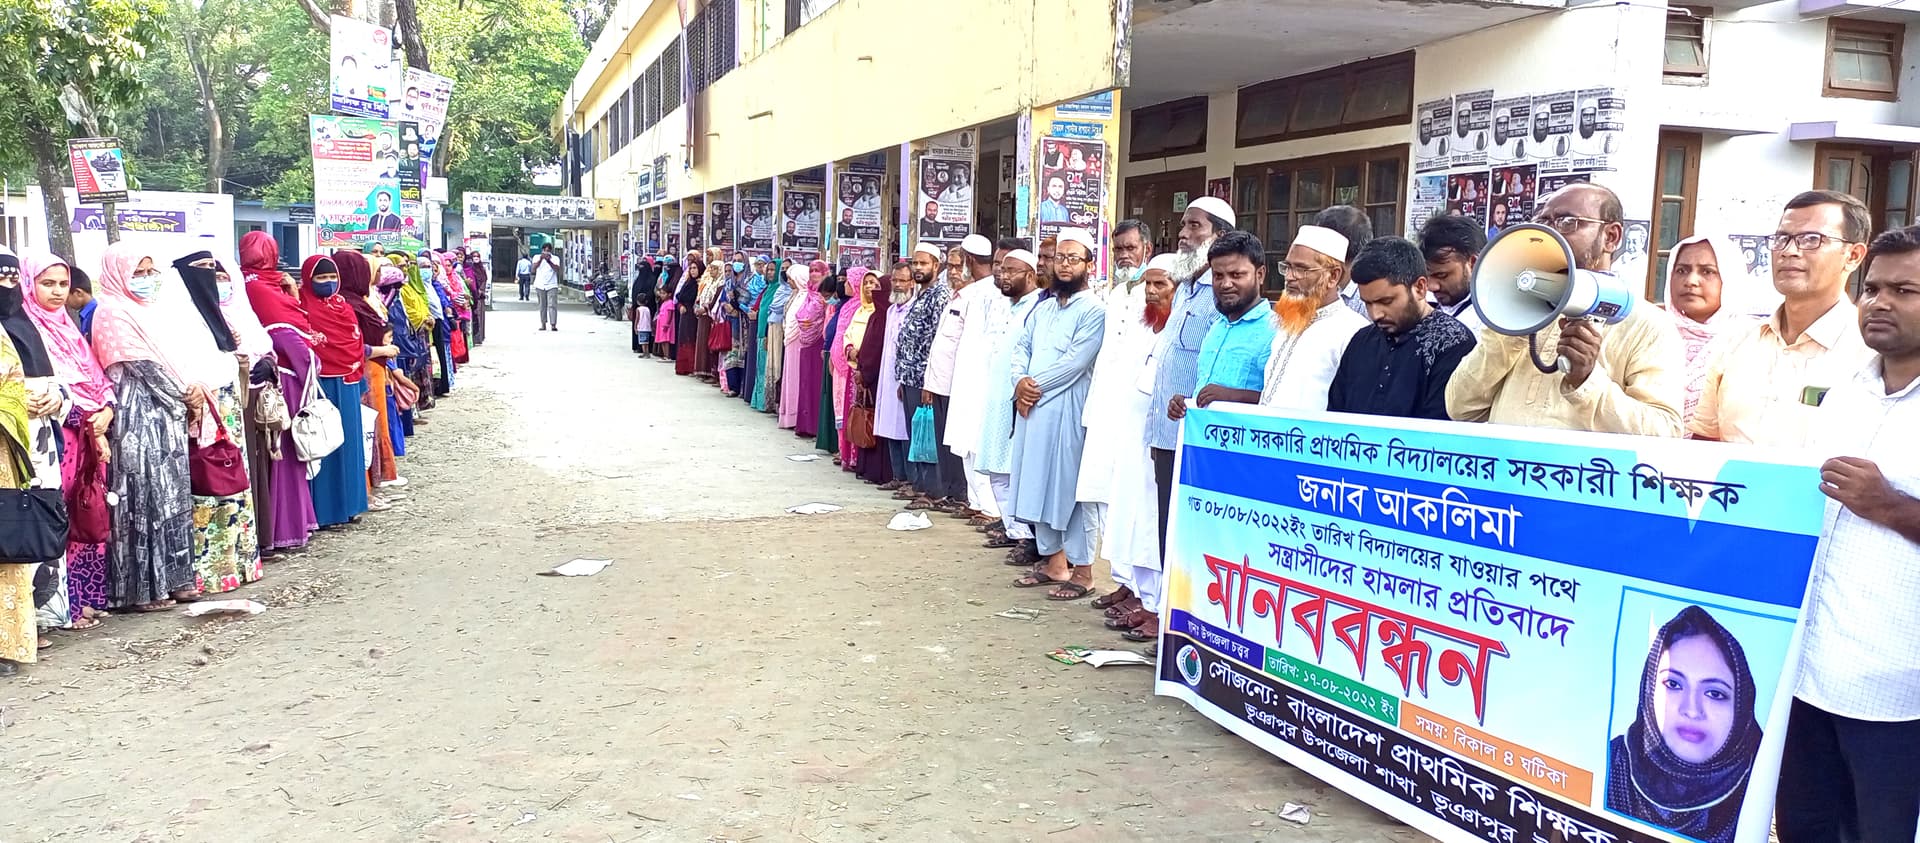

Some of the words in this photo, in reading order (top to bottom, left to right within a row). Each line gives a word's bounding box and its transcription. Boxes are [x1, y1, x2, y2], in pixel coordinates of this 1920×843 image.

[1204, 423, 1246, 448] বেতুয়া
[1250, 427, 1306, 454] সরকারি
[1310, 432, 1382, 464] প্রাথমিক
[1387, 437, 1499, 482] বিদ্যালয়ের
[1507, 457, 1620, 498] সহকারী
[1628, 463, 1747, 512] শিক্ষক
[1296, 474, 1369, 518] জনাব
[1373, 486, 1524, 548] আকলিমা
[1268, 542, 1357, 587] সন্ত্রাসীদের
[1361, 566, 1442, 611] হামলার
[1448, 587, 1575, 647] প্রতিবাদে
[1311, 523, 1355, 550] তারিখ
[1358, 529, 1444, 572] বিদ্যালয়ের
[1449, 555, 1522, 590] যাওয়ার
[1529, 572, 1581, 603] পথে
[1200, 624, 1230, 651] উপজেলা
[1203, 553, 1511, 727] মানববন্ধন
[1303, 670, 1377, 714] ১৭-০৮-২০২২
[1379, 697, 1396, 720] ইং
[1286, 694, 1386, 757] বাংলাদেশ
[1390, 744, 1498, 805] প্রাথমিক
[1505, 785, 1618, 843] শিক্ষক
[1302, 726, 1370, 775] উপজেলা
[1374, 763, 1422, 804] শাখা,
[1453, 727, 1497, 761] বিকাল
[1503, 751, 1514, 767] ৪
[1520, 755, 1569, 790] ঘটিকা
